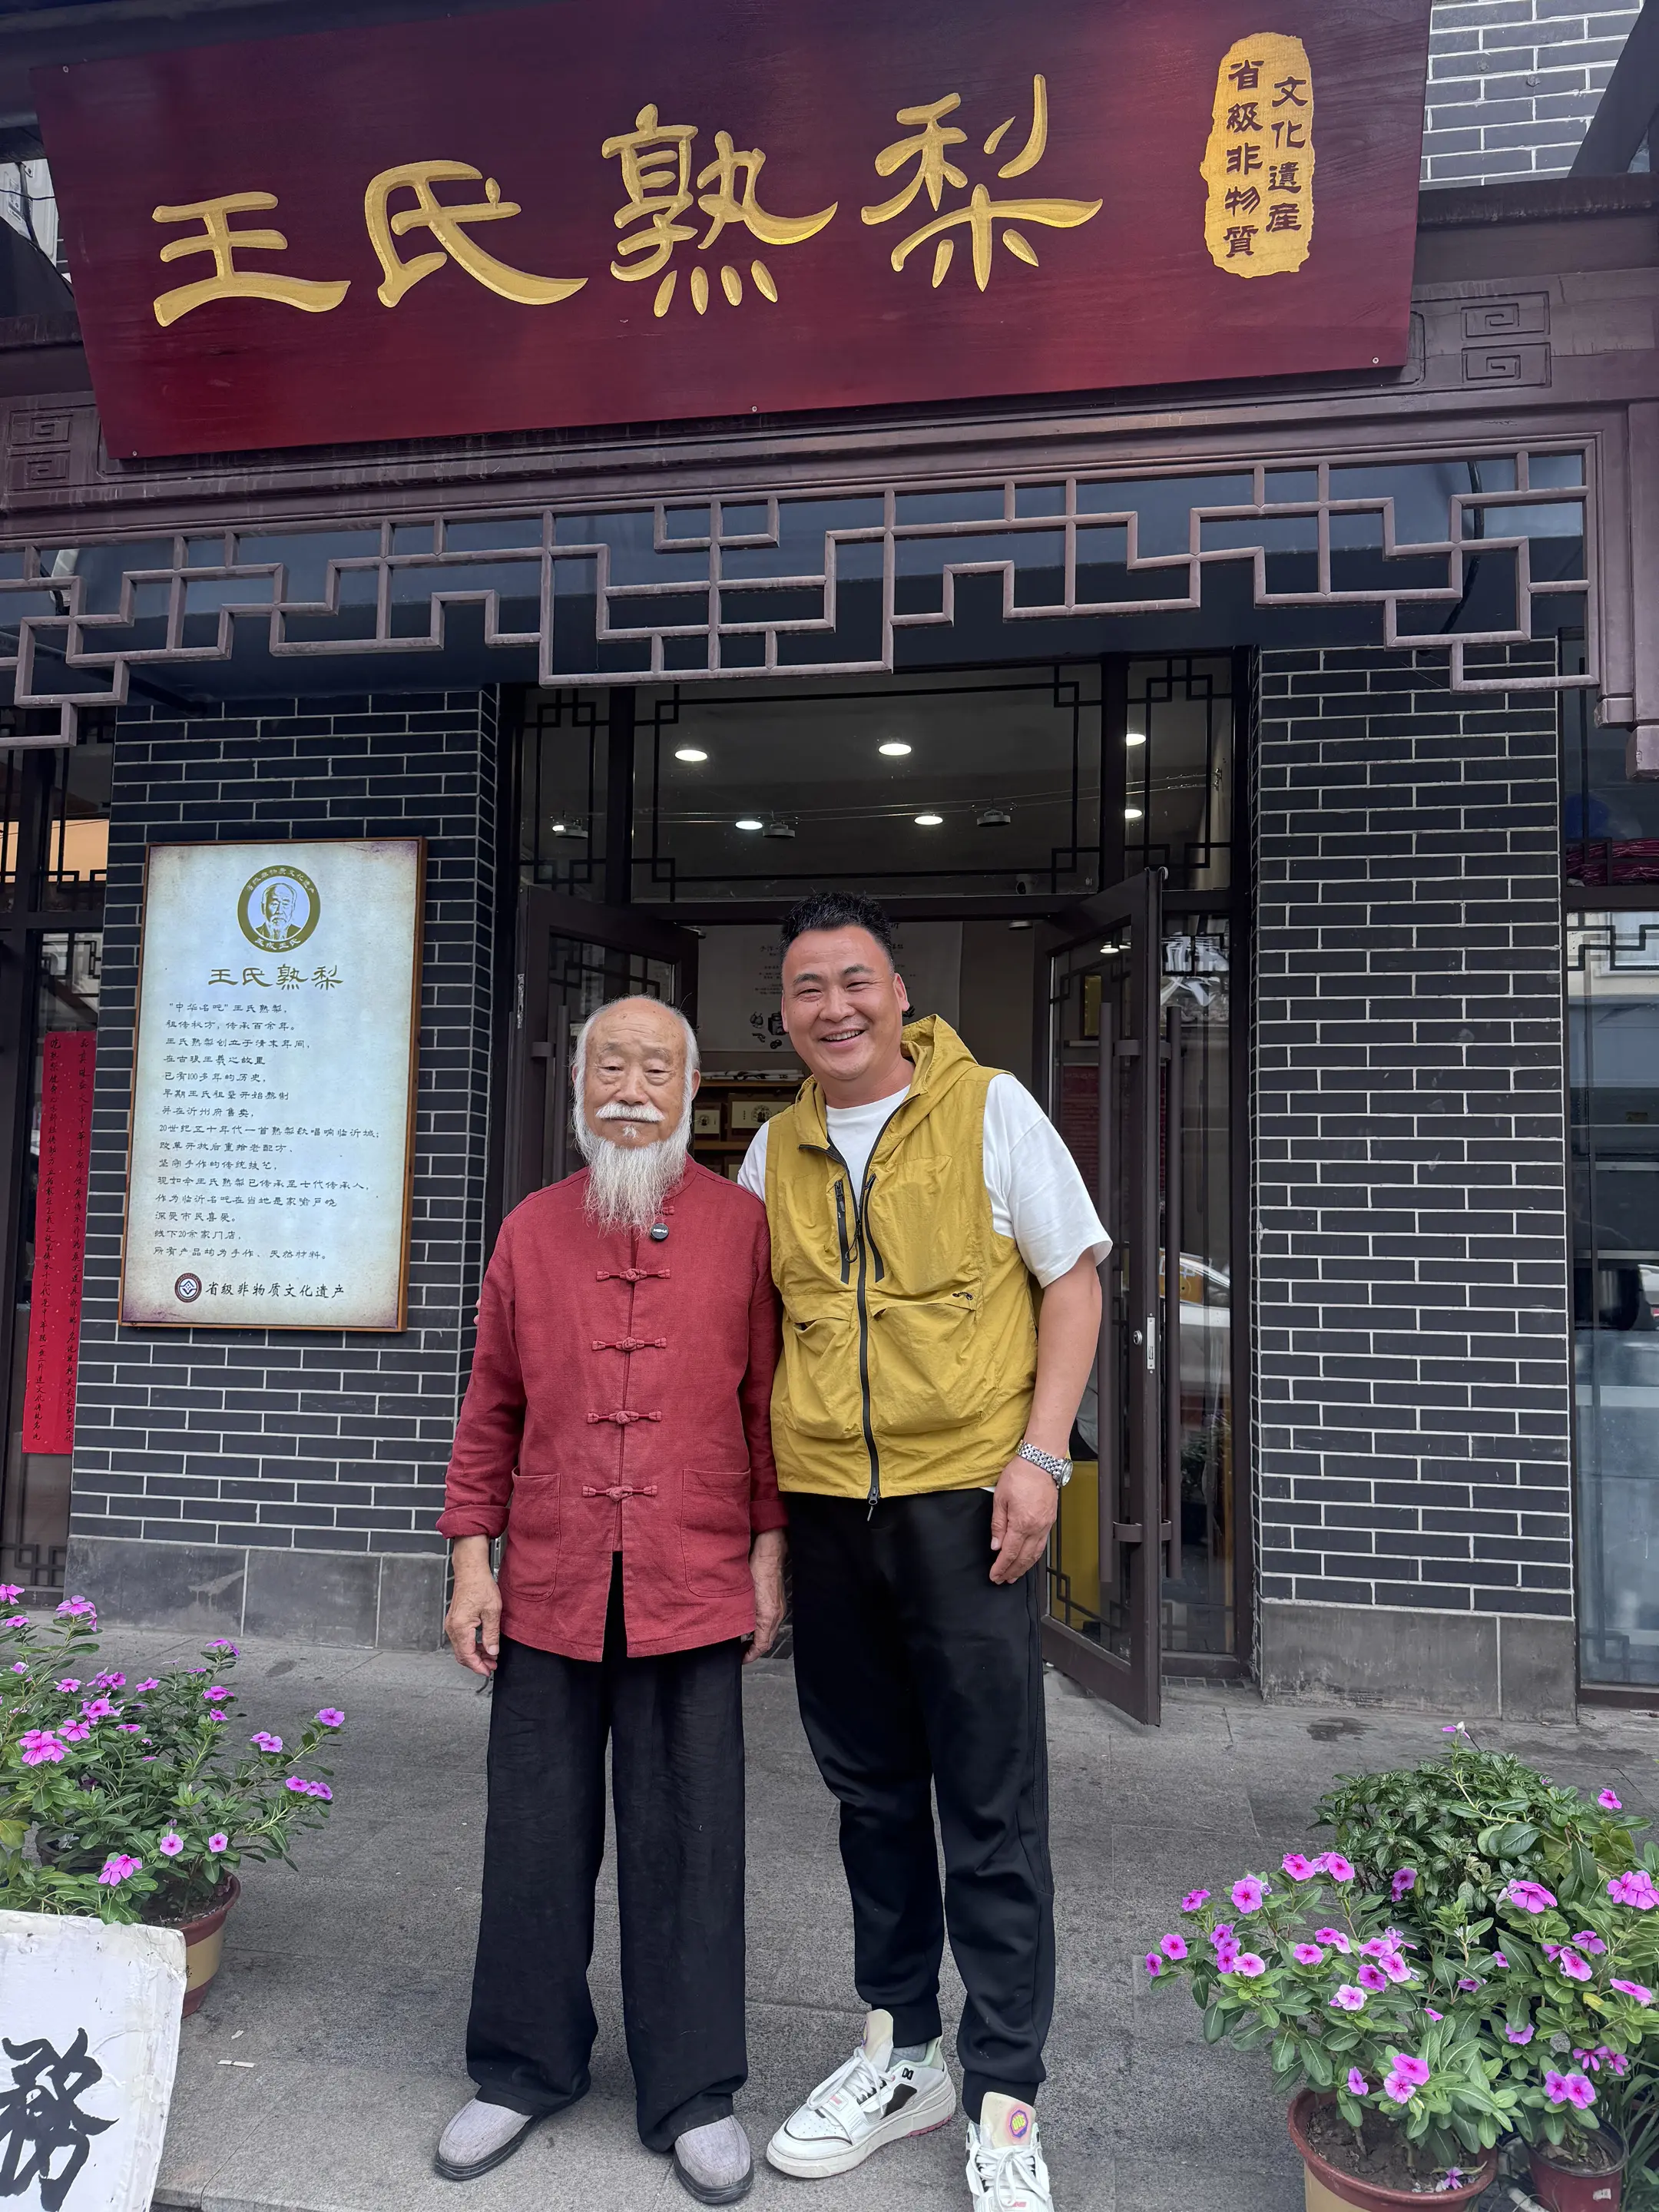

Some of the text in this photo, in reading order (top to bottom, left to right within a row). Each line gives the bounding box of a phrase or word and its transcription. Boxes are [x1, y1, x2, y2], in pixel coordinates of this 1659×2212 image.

[152, 75, 1102, 326] 王氏熟梨
[1223, 59, 1264, 258] 省級非物質
[208, 963, 344, 991] 王氏熟梨
[205, 1281, 345, 1299] 省级非物质文化遗产
